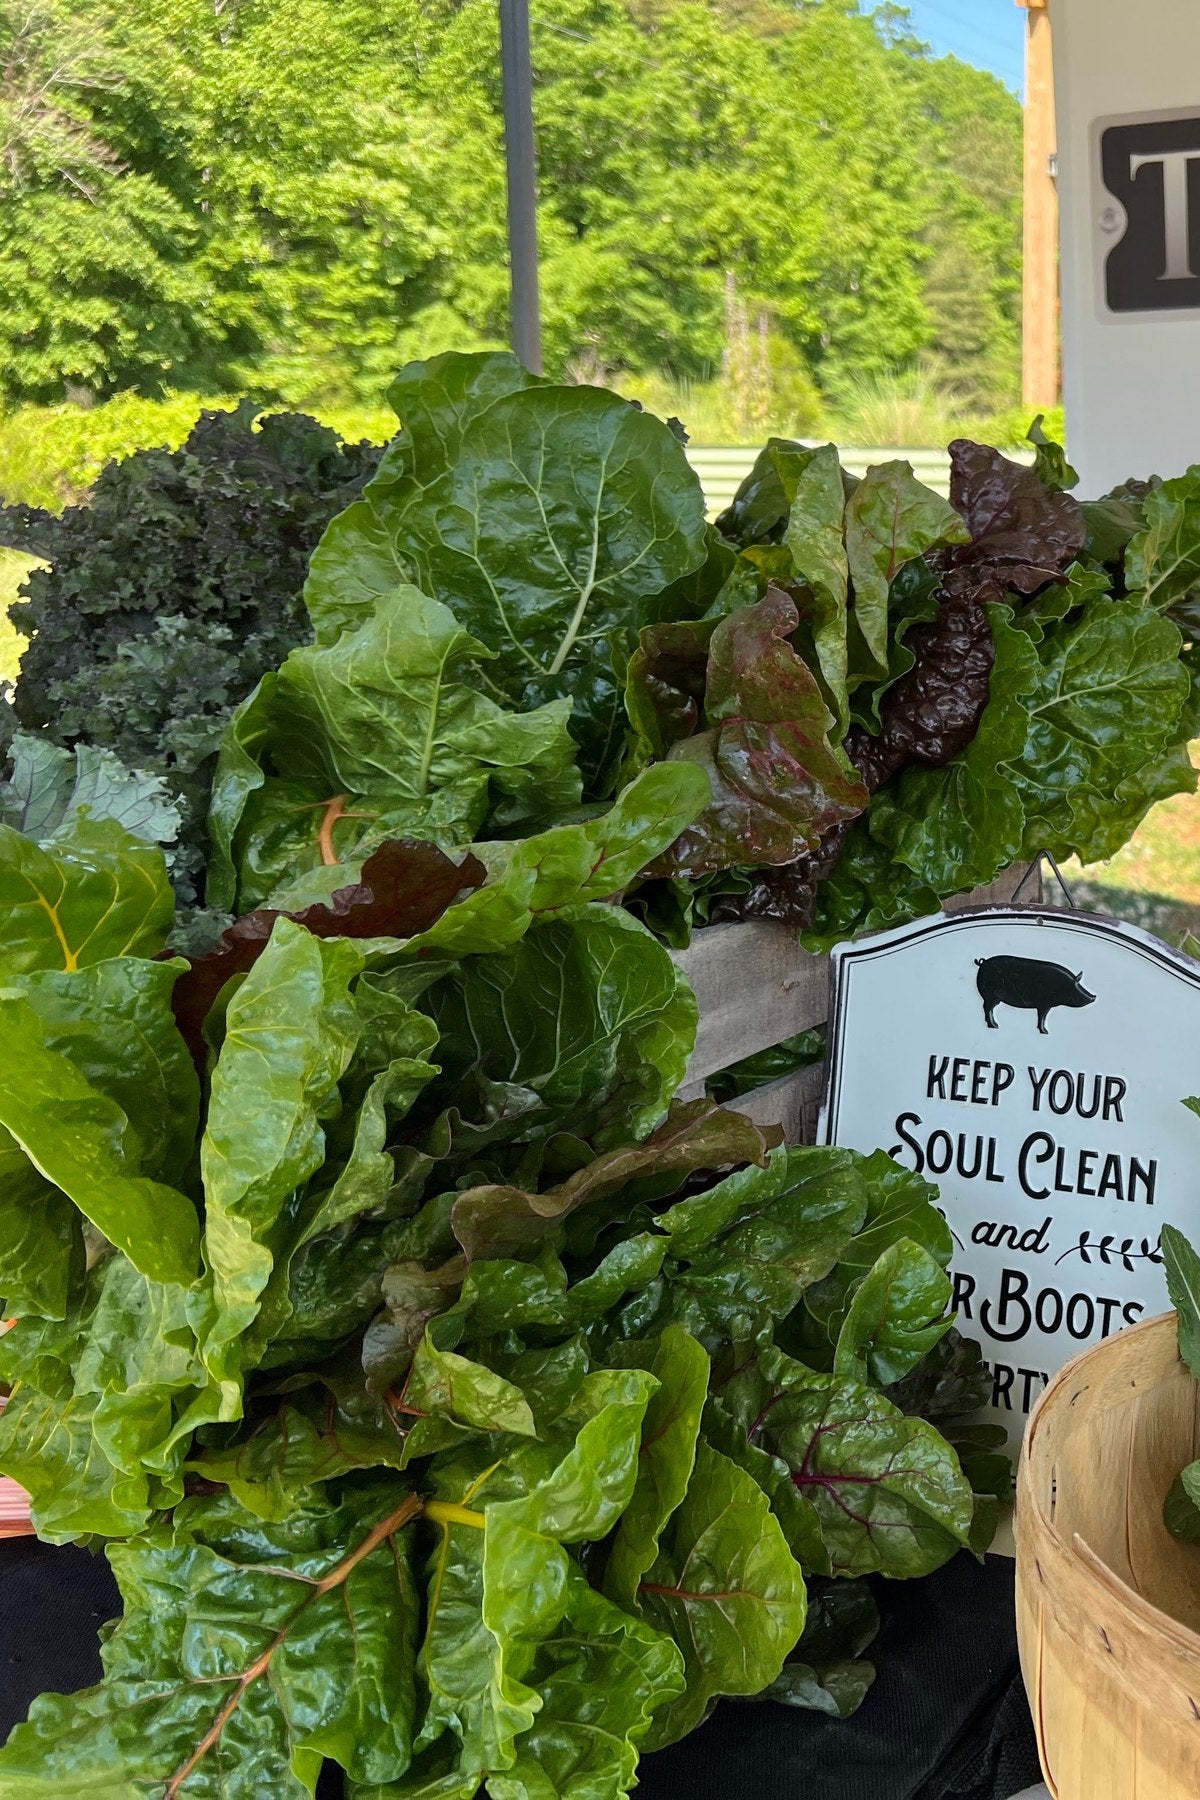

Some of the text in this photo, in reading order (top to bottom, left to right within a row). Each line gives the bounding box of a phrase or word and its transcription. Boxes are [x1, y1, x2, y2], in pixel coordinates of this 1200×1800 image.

[926, 1054, 1127, 1122] KEEP YOUR
[888, 1111, 1157, 1205] SOUL CLEAN
[971, 1216, 1053, 1254] and
